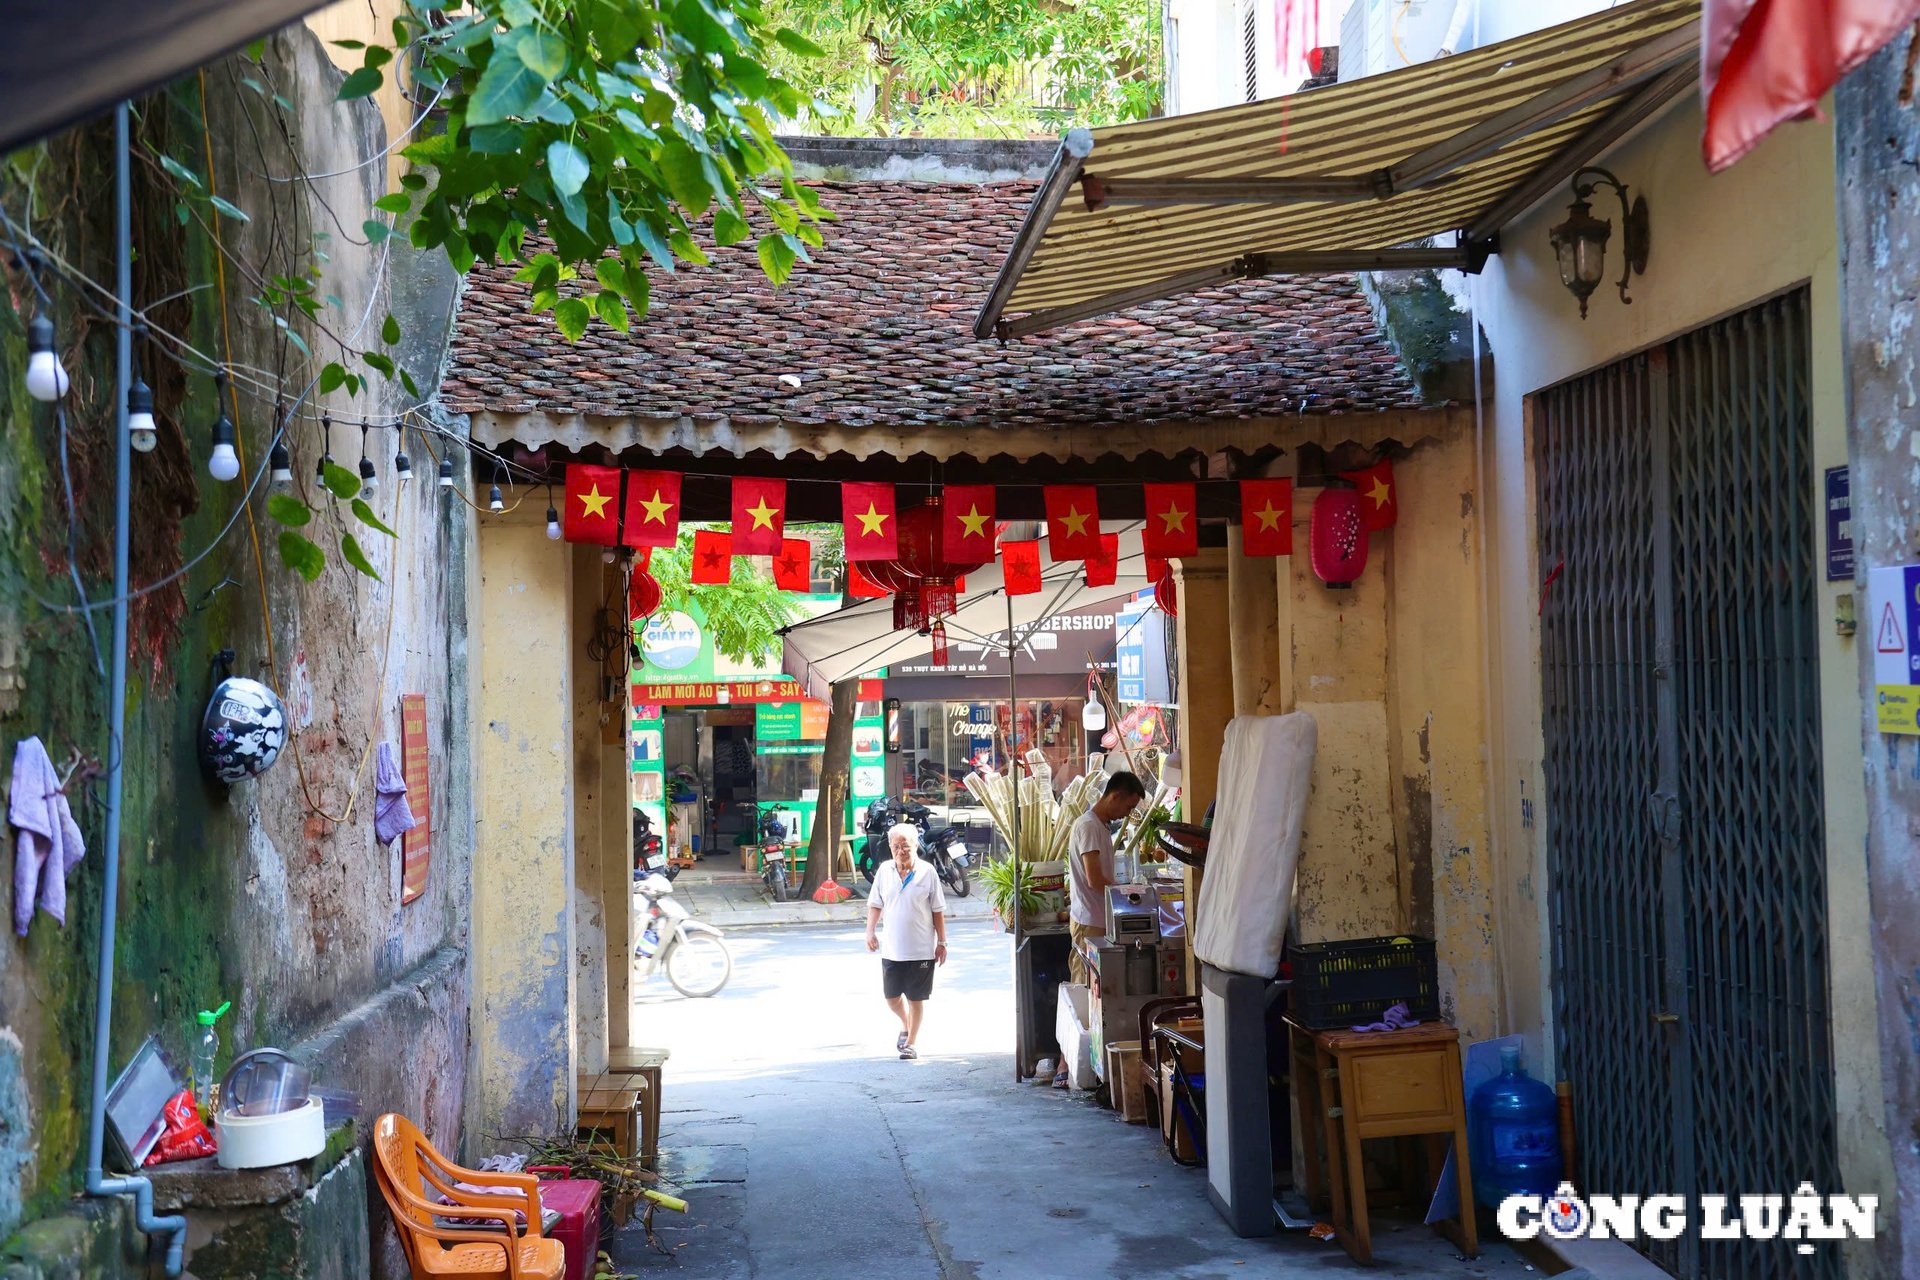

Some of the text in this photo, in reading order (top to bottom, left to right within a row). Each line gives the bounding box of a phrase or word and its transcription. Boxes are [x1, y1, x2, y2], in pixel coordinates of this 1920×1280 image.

[648, 684, 672, 700] LÀM
[674, 683, 696, 699] MỚI
[735, 681, 752, 698] TÚI
[952, 720, 997, 738] Change
